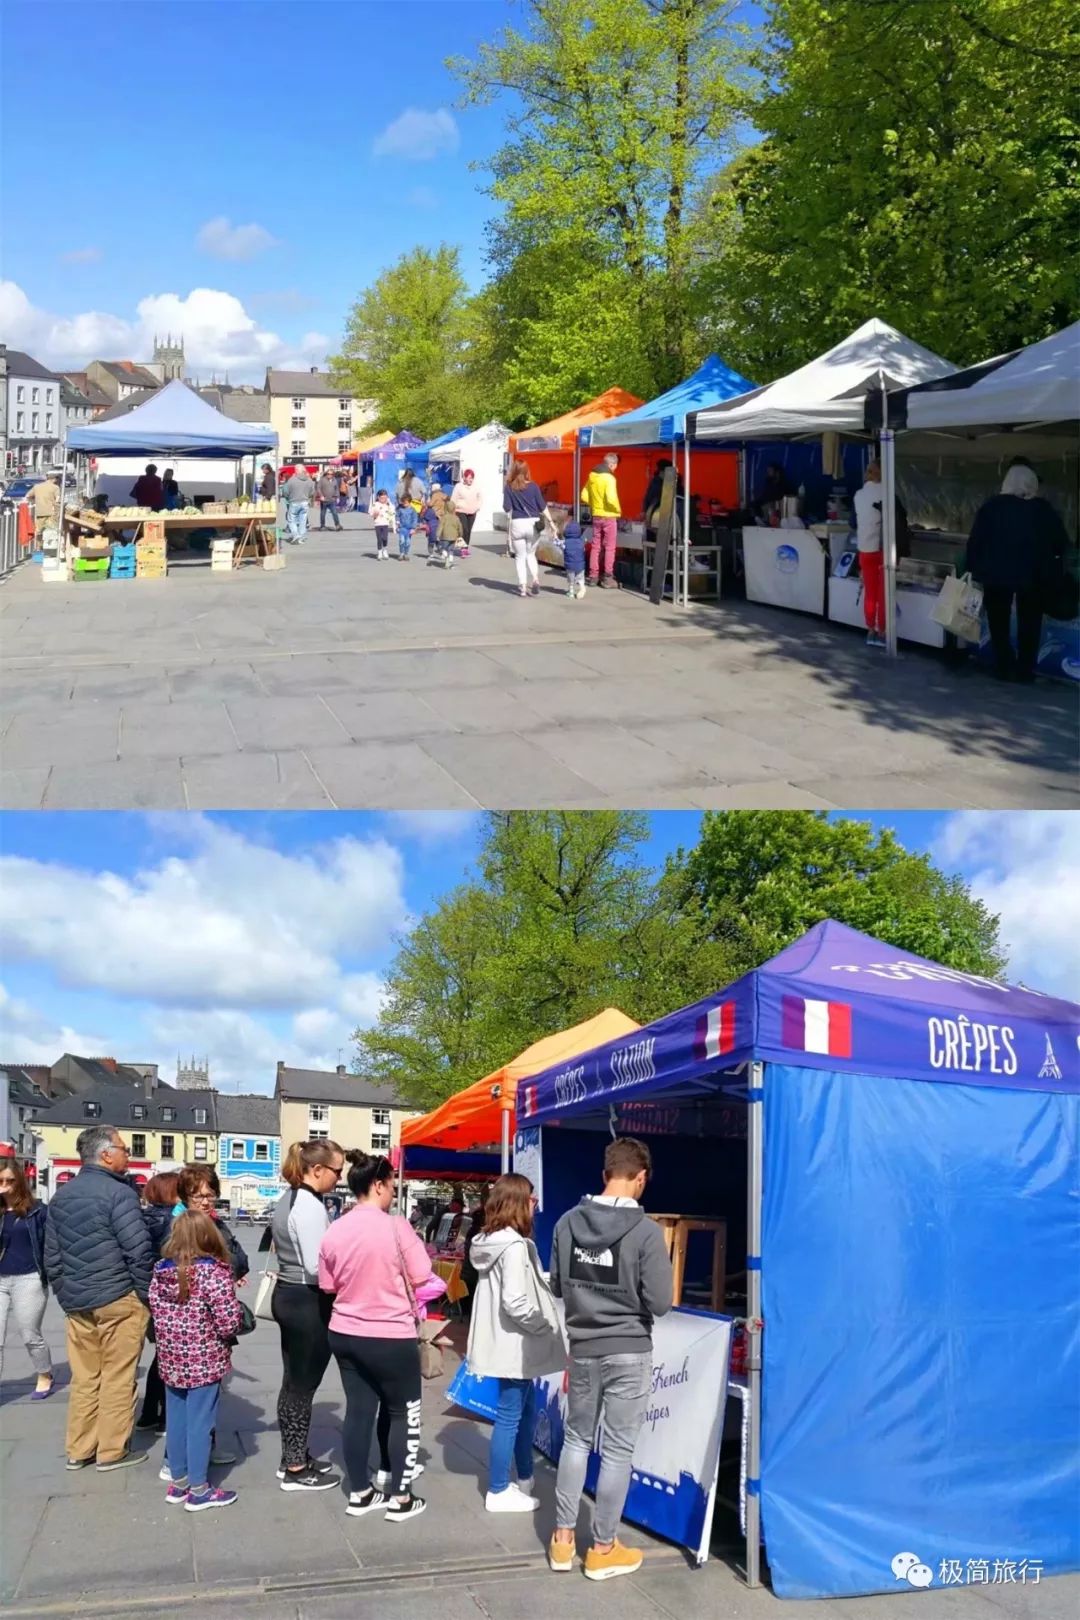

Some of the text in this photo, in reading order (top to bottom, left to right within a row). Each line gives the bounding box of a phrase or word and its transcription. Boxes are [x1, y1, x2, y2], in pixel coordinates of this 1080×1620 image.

[610, 1037, 656, 1091] STATION
[928, 1014, 1018, 1075] CRÊPES
[651, 1355, 689, 1394] French
